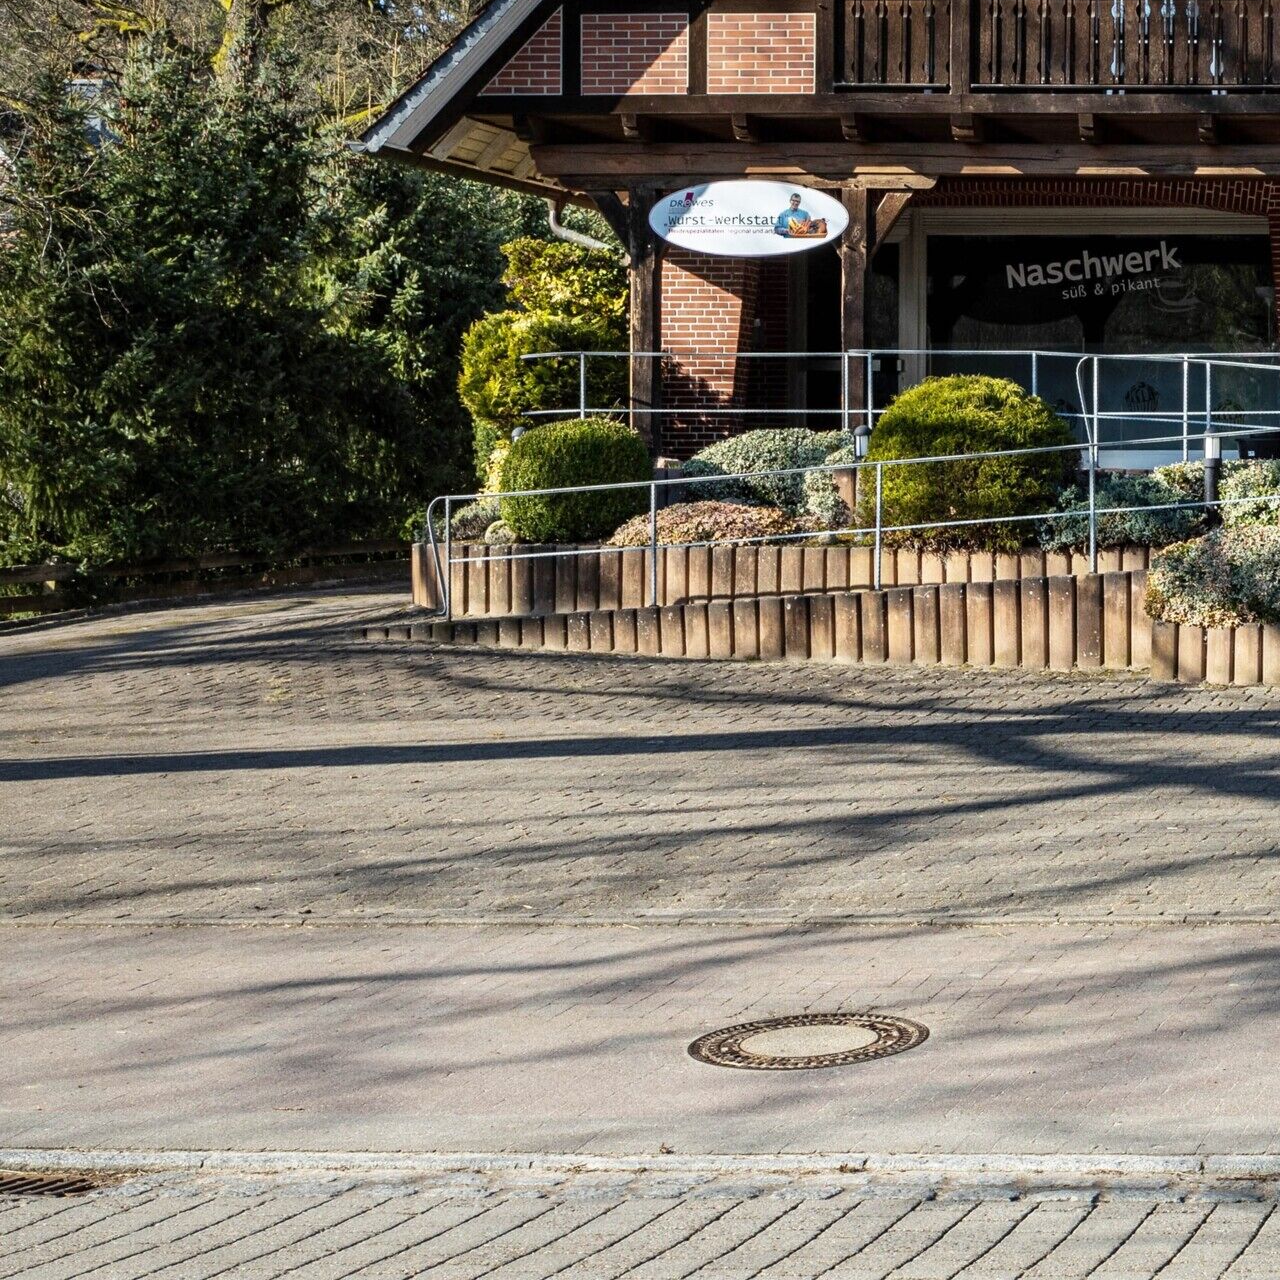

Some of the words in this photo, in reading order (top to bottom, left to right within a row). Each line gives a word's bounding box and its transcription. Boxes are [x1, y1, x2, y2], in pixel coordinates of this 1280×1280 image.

[1005, 240, 1182, 289] Naschwerk
[1062, 286, 1087, 300] süß
[1094, 283, 1104, 296] &
[1111, 277, 1161, 295] pikant
